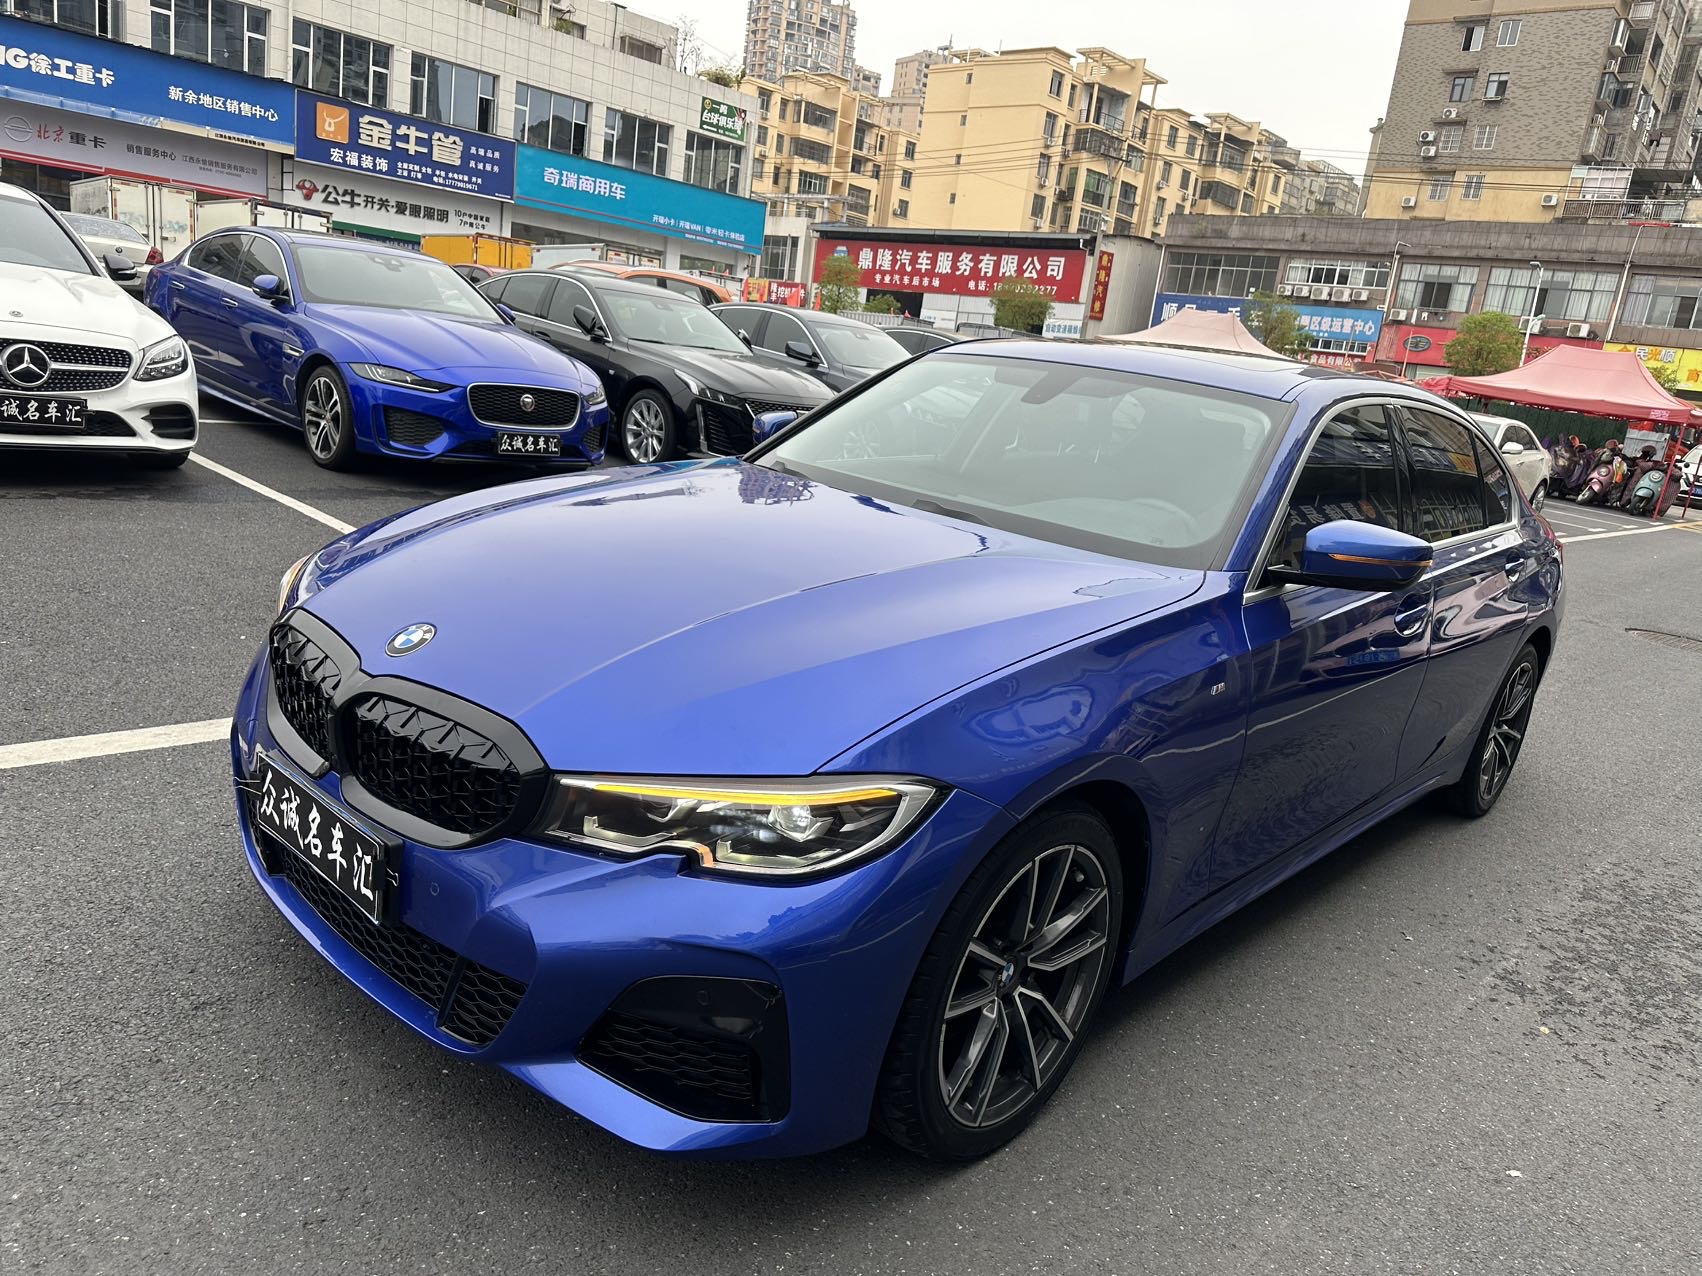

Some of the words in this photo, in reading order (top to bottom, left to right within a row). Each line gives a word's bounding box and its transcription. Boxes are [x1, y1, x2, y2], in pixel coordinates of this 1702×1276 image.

[0, 45, 115, 88] G徐工重卡
[168, 85, 279, 122] 新余地区销售中心
[37, 123, 107, 149] 北京重卡
[126, 143, 177, 161] 销售服务中心
[330, 147, 389, 173] 宏福装饰
[469, 145, 501, 160] 高端品质
[468, 159, 500, 174] 真诚服务
[543, 167, 627, 200] 奇瑞商用车
[857, 247, 1066, 280] 鼎隆汽车服务有限公司
[874, 273, 941, 288] 专业汽车后市场
[500, 434, 559, 453] 众诚名车汇
[260, 768, 374, 901] 众诚名车汇
